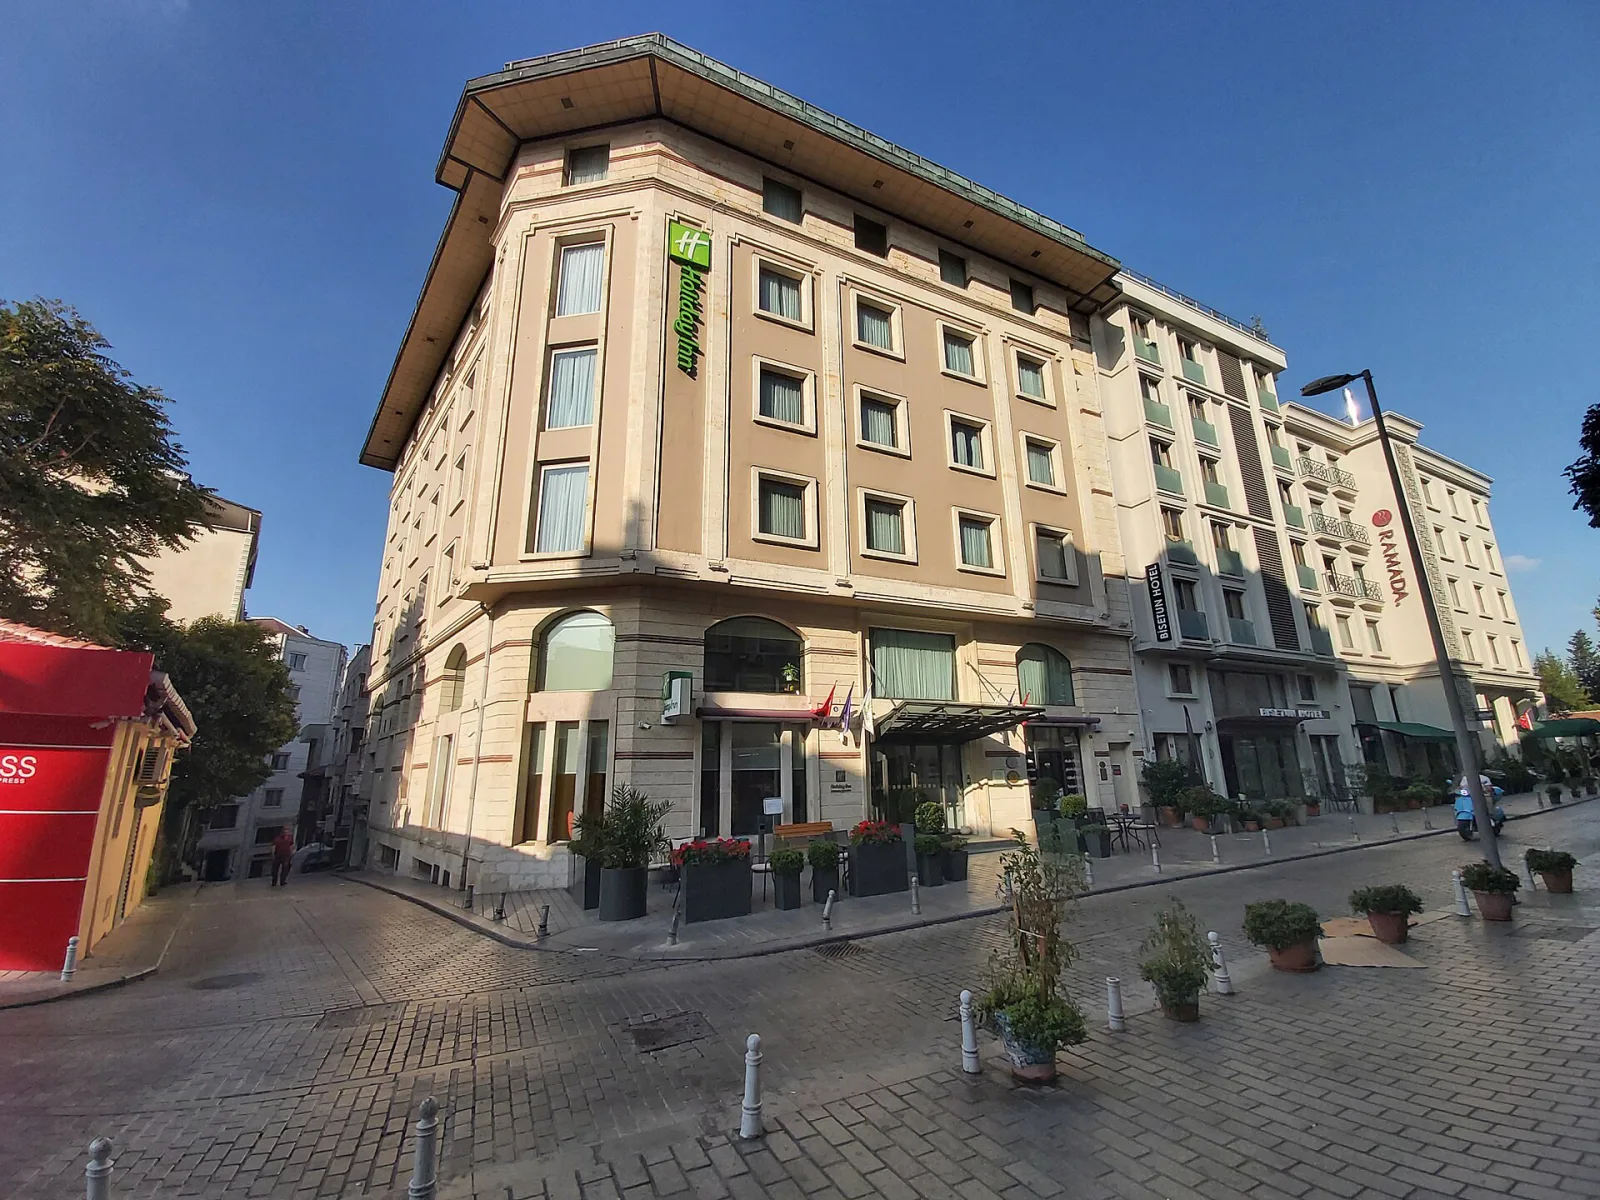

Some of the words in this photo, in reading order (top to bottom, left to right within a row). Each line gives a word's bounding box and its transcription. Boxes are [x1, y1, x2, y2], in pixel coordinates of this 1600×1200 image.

[673, 265, 703, 337] Holiday
[679, 336, 699, 369] Inn
[1148, 564, 1162, 597] HOTEL
[1298, 709, 1325, 718] HOTEL
